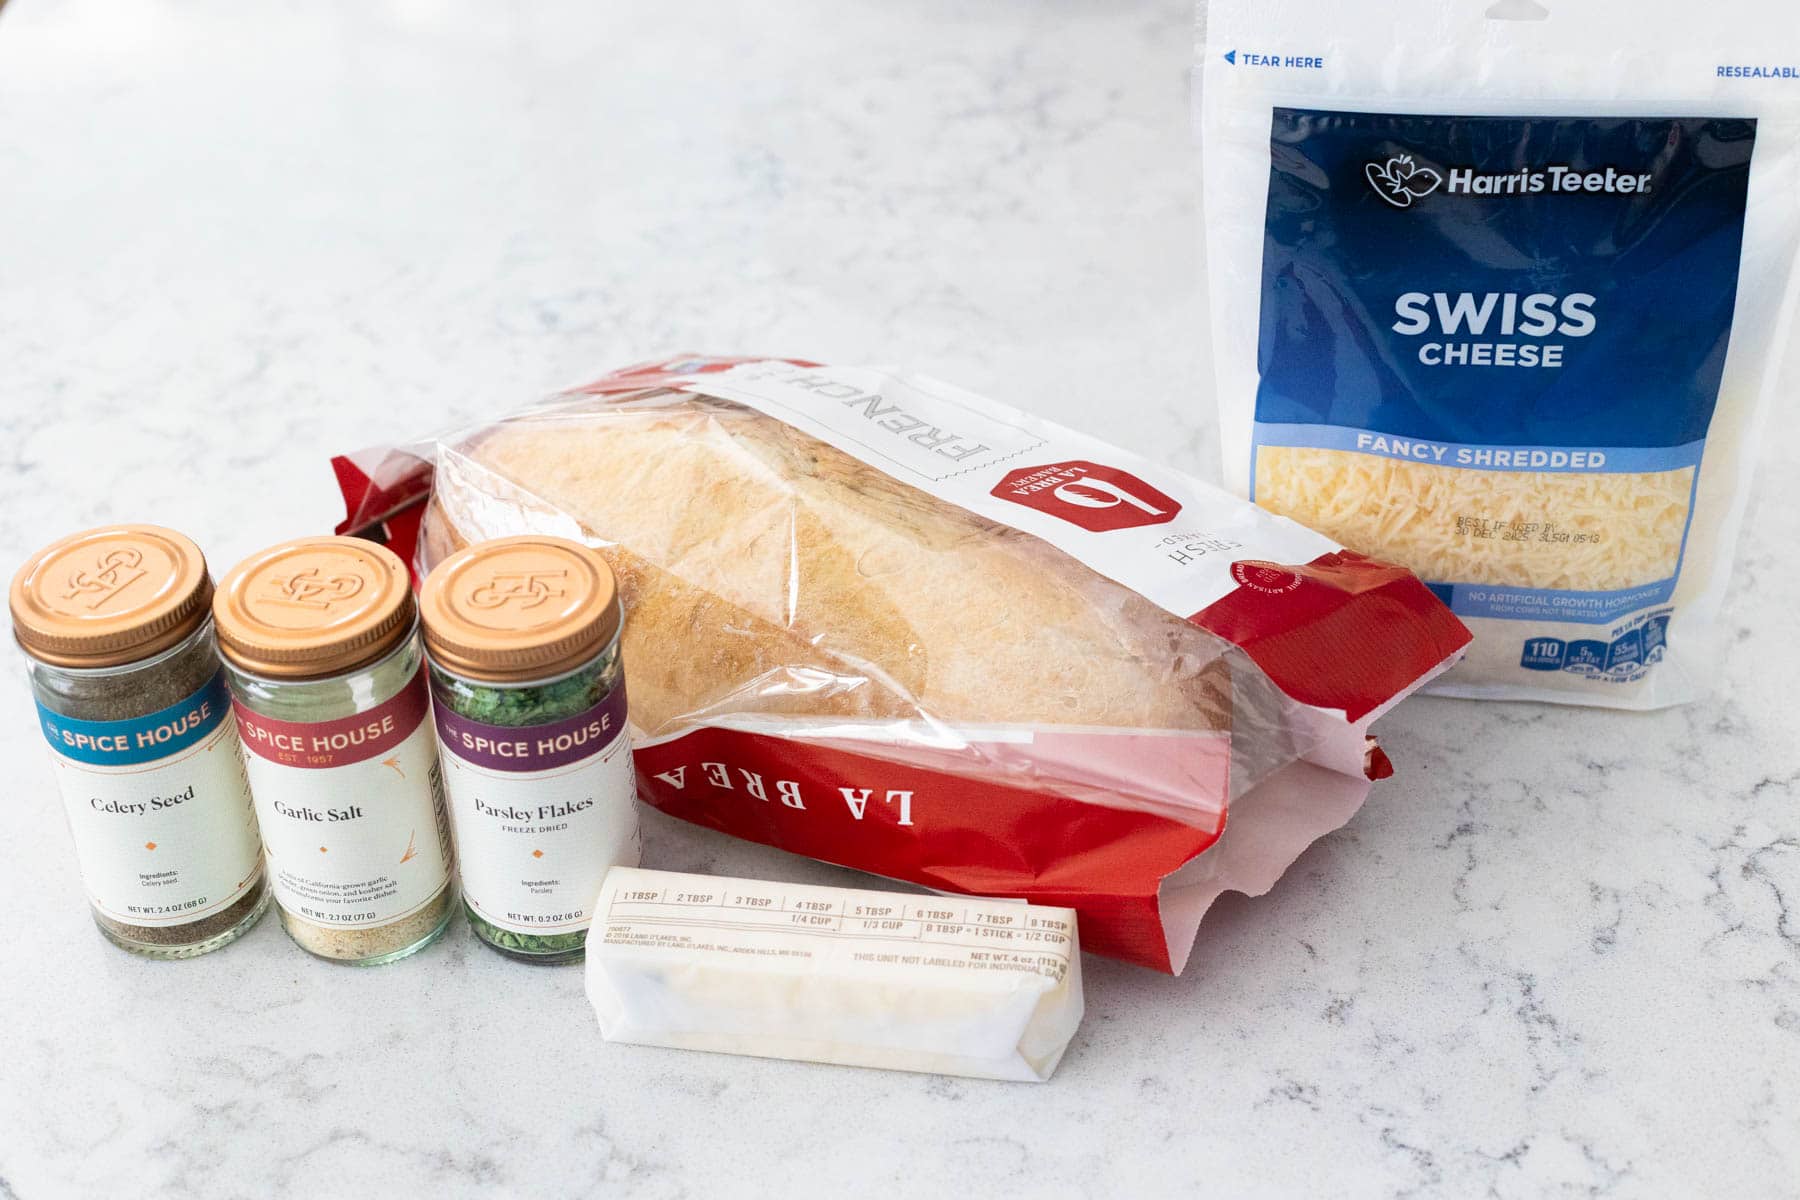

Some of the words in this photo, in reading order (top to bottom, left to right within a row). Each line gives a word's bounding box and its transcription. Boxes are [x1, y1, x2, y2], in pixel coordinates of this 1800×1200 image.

[1243, 54, 1280, 67] TEAR
[1285, 56, 1323, 68] HERE
[1717, 66, 1800, 78] RESEALABL
[1448, 168, 1545, 194] Harris
[1548, 166, 1651, 194] Teeter
[1391, 292, 1597, 338] SWISS
[1418, 342, 1564, 368] CHEESE
[786, 375, 990, 462] FRENCH
[1357, 433, 1448, 461] FANCY
[1456, 448, 1606, 469] SHREDDED
[1008, 466, 1062, 489] BAKERY
[1059, 467, 1089, 478] LA
[1012, 477, 1065, 496] BREA
[1457, 516, 1488, 529] BEST
[1493, 521, 1507, 531] IF
[1455, 527, 1469, 536] 30
[1473, 528, 1497, 539] DEC
[1468, 592, 1486, 602] NO
[1489, 592, 1550, 606] ARTIFICIAL
[1552, 596, 1604, 609] GROWTH
[1542, 607, 1559, 616] NOT
[1561, 607, 1598, 618] TREATED
[1530, 642, 1559, 657] 110
[62, 730, 130, 751] SPICE
[136, 701, 212, 748] HOUSE
[246, 721, 305, 752] SPICE
[312, 715, 395, 752] HOUSE
[462, 732, 529, 757] SPICE
[538, 713, 611, 756] HOUSE
[307, 754, 334, 764] 1957
[653, 762, 807, 811] BREA
[90, 798, 147, 816] Celery
[151, 785, 195, 811] Seed
[838, 787, 914, 826] LA
[274, 800, 323, 822] Garlic
[327, 805, 363, 822] Salt
[475, 798, 534, 823] Parsley
[538, 797, 594, 820] Flakes
[502, 825, 537, 834] FREEZE
[539, 822, 568, 833] DRIED
[140, 870, 178, 880] Ingredients:
[367, 876, 388, 887] garlic
[359, 885, 383, 895] kosher
[385, 880, 398, 889] salt
[343, 896, 373, 904] favorite
[624, 892, 628, 900] 1
[632, 892, 658, 901] TBSP
[677, 893, 684, 901] 2
[687, 894, 713, 903] TBSP
[736, 896, 743, 904] 3
[745, 897, 772, 907] TBSP
[128, 905, 141, 913] NET
[158, 906, 170, 914] 2.4
[172, 904, 182, 912] OZ
[198, 897, 207, 905] G)
[806, 902, 832, 912] TBSP
[855, 906, 863, 915] 5
[865, 907, 892, 917] TBSP
[301, 906, 312, 917] NET
[354, 913, 366, 921] (77
[508, 912, 521, 920] NET
[565, 912, 573, 920] (6
[574, 910, 583, 918] G)
[791, 914, 807, 923] 1/4
[810, 915, 832, 926] CUP
[917, 910, 923, 919] 6
[927, 910, 954, 920] TBSP
[976, 913, 982, 922] 7
[986, 914, 1013, 925] TBSP
[863, 920, 878, 929] 1/3
[881, 920, 903, 931] CUP
[1031, 918, 1037, 927] 8
[1041, 918, 1068, 931] TBSP
[926, 924, 932, 932] 8
[936, 924, 963, 935] TBSP
[974, 928, 979, 936] 1
[982, 929, 1013, 940] STICK
[1025, 931, 1041, 941] 1/2
[1044, 933, 1065, 944] CUP
[854, 953, 875, 963] THIS
[877, 954, 899, 964] UNIT
[901, 955, 920, 965] NOT
[923, 956, 966, 968] LABELED
[968, 960, 988, 970] FOR
[989, 961, 1041, 975] INDIVIDUAL
[970, 952, 990, 961] NET
[1011, 954, 1017, 963] 4
[1037, 957, 1057, 968] (113
